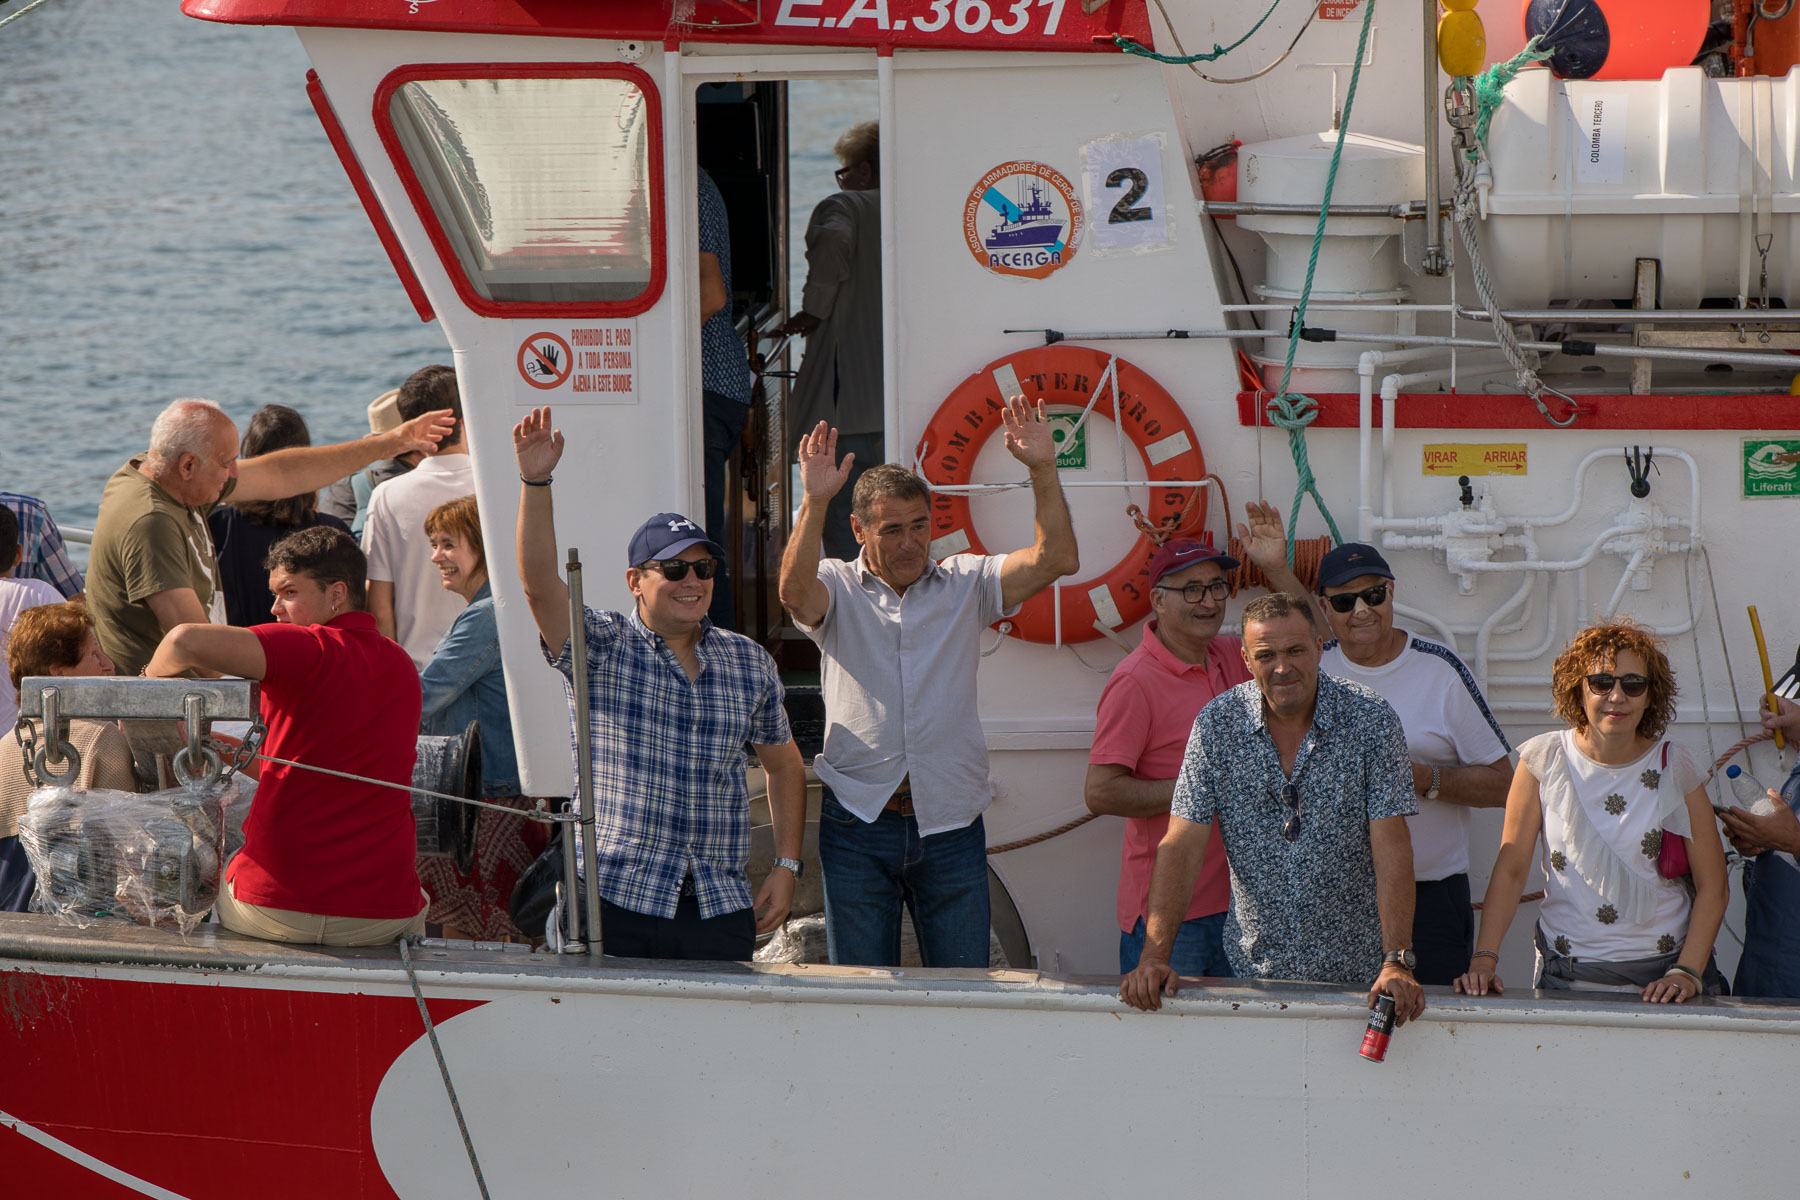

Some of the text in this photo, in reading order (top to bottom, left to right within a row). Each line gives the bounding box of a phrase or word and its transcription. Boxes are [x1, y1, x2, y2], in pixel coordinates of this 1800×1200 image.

[774, 0, 1066, 35] E.A.3631
[1590, 100, 1604, 163] COLOMBA TERCERO
[983, 163, 1037, 187] ARMADORES
[1038, 166, 1052, 178] DE
[973, 185, 985, 199] DE
[1051, 174, 1073, 200] CERCO
[1105, 167, 1153, 225] 2
[1070, 201, 1080, 214] DE
[966, 200, 983, 254] ASOCIACION
[989, 251, 1061, 268] ACERGA
[571, 328, 632, 346] PROHIBIDO EL PASO
[578, 352, 632, 369] A TODA PERSONA
[572, 374, 632, 394] AJENA A ESTE BUQUE
[1423, 451, 1527, 463] VIRAR ARRIAR
[1752, 482, 1793, 492] Liferaft
